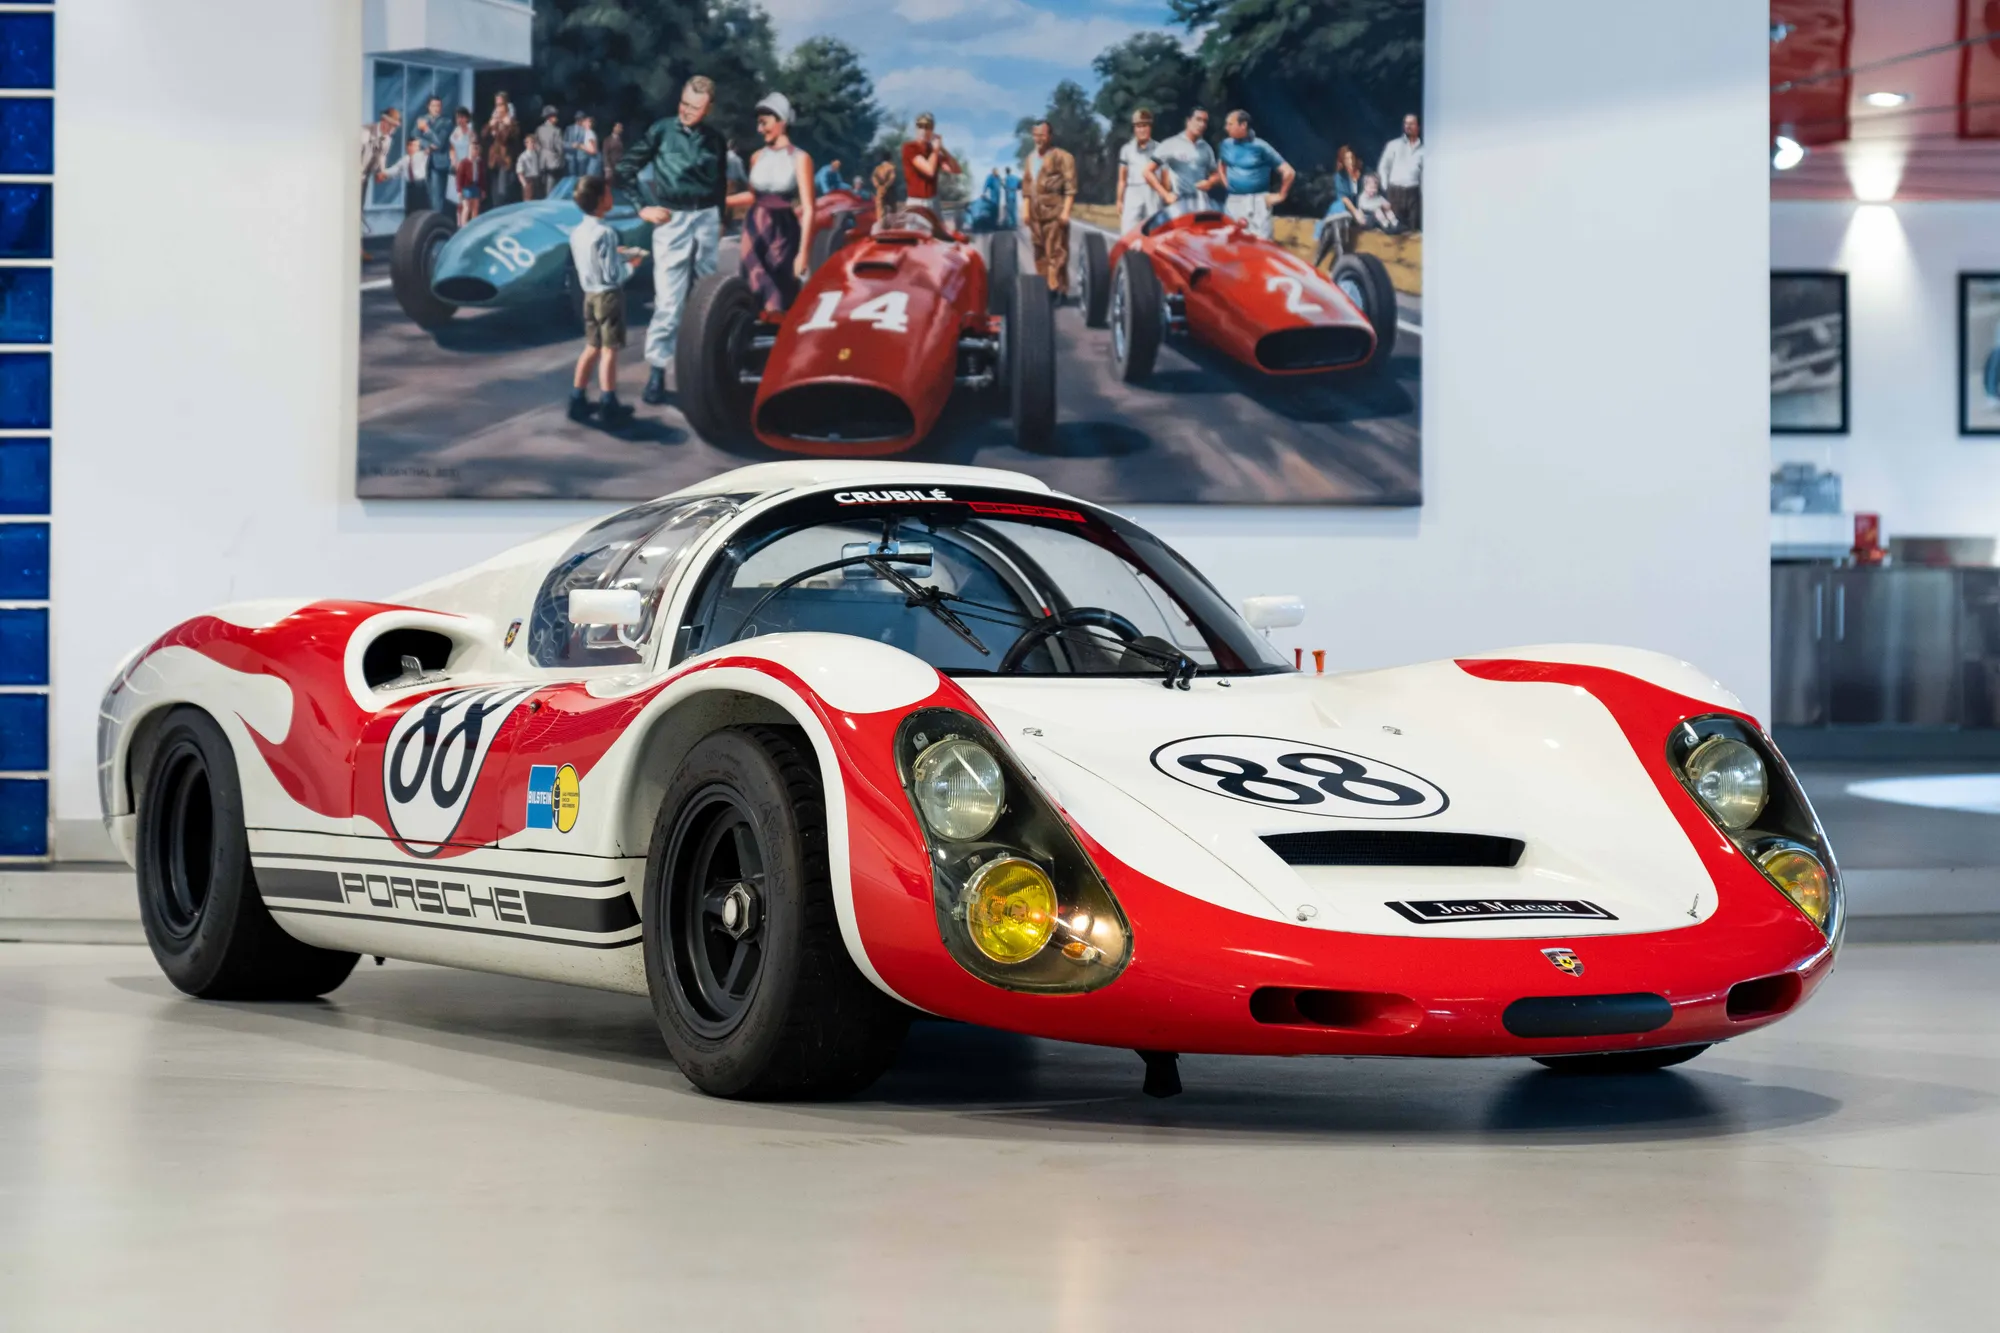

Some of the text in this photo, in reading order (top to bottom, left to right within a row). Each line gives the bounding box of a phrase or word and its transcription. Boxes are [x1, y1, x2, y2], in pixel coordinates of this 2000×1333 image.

[484, 236, 536, 273] 18
[797, 290, 910, 333] 14
[1266, 275, 1322, 315] 2
[833, 488, 953, 504] CRUBILÉ
[971, 503, 1077, 518] SPORT
[390, 686, 540, 808] 88
[528, 790, 553, 804] BILSTEIN
[1176, 752, 1426, 807] 88
[341, 872, 527, 925] PORSCHE
[1433, 901, 1575, 915] Joe Macari
